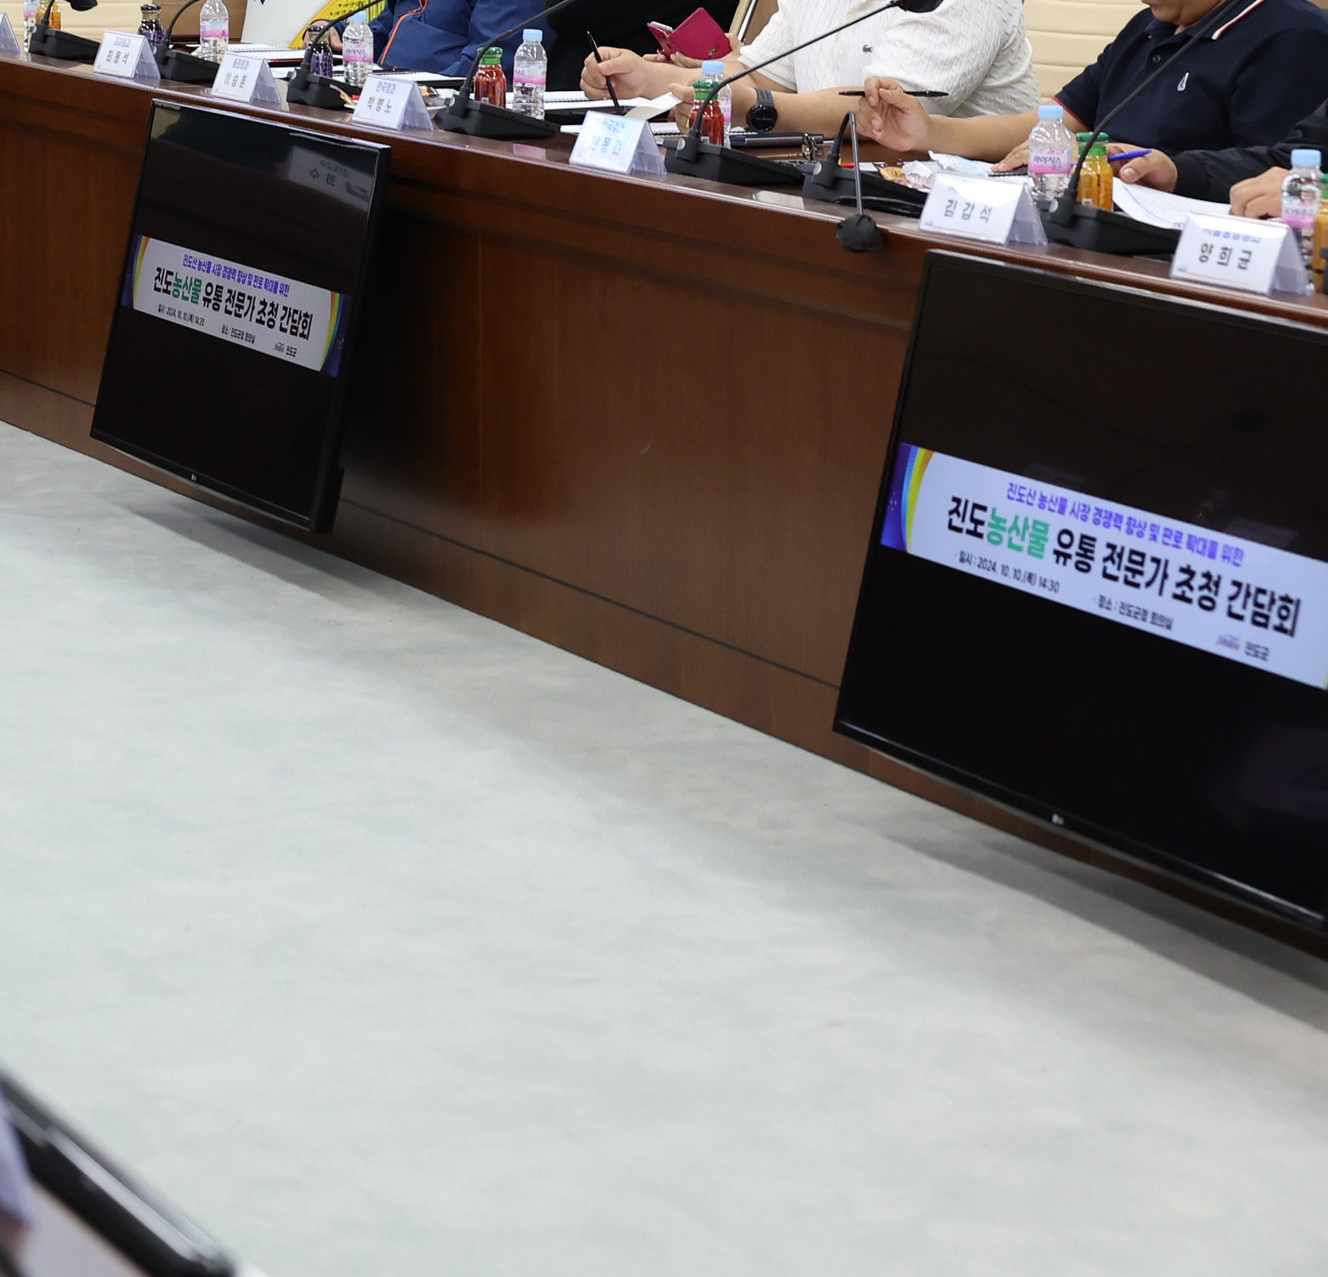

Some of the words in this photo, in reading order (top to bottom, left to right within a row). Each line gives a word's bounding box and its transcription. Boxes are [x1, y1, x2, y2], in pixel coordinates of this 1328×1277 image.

[153, 266, 202, 304] 진도농산물
[202, 281, 224, 311] 유통
[224, 288, 256, 322] 전문가
[254, 298, 279, 329] 초청
[278, 305, 313, 340] 간담회
[947, 495, 1048, 558] 진도농산물
[1052, 528, 1097, 573] 유통
[1101, 542, 1169, 596] 전문가
[1171, 564, 1221, 612] 초청
[1226, 579, 1301, 637] 간담회
